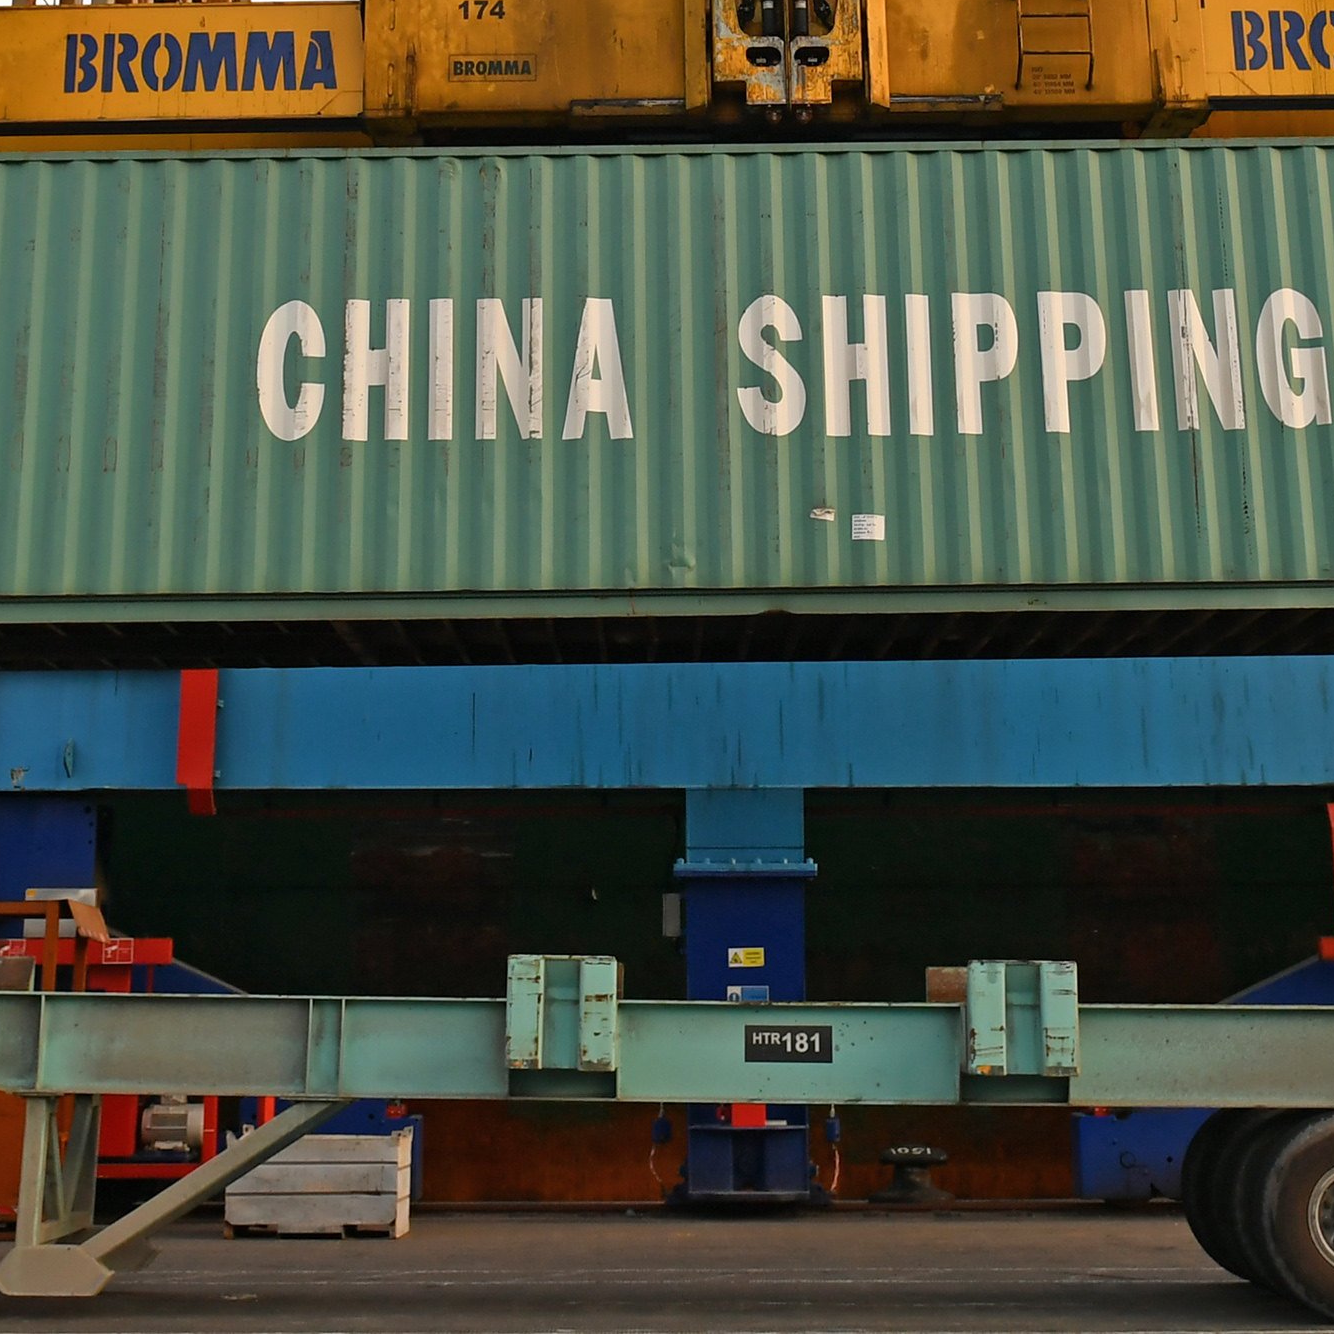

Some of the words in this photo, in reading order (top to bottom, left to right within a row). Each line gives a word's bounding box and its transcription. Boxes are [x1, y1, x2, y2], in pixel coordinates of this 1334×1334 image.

[458, 0, 506, 20] 174
[63, 30, 338, 93] BROMMA
[453, 60, 532, 76] BROMMA
[256, 297, 634, 442] CHINA
[736, 287, 1333, 437] SHIPPING
[752, 1031, 821, 1053] HTR181
